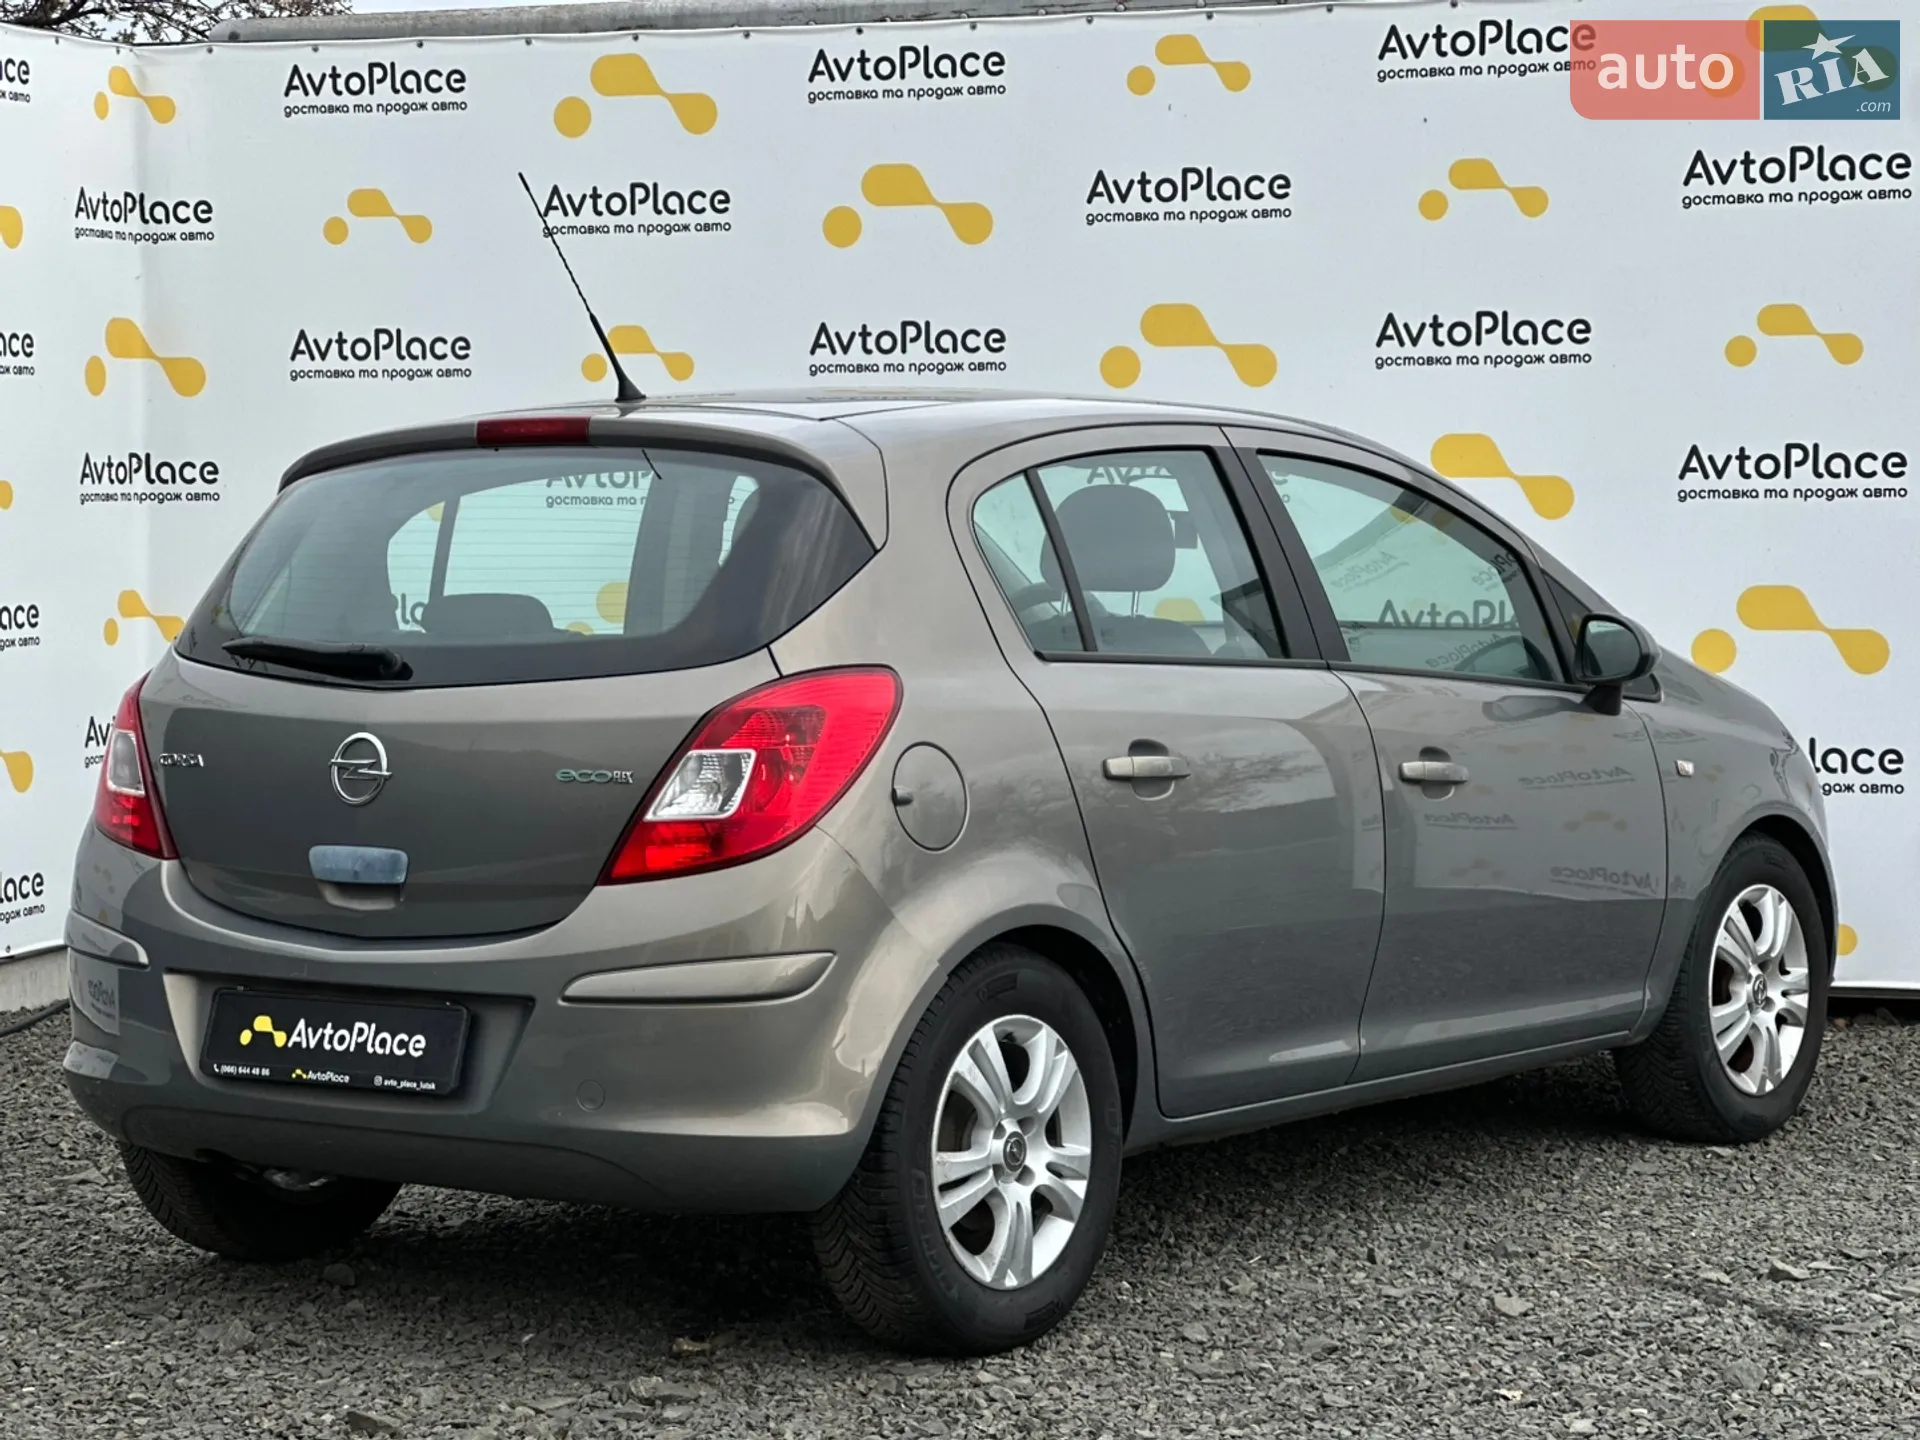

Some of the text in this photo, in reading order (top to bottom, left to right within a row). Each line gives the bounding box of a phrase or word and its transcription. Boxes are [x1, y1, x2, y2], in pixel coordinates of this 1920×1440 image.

[1377, 18, 1597, 61] AvtoPlace
[0, 57, 30, 85] ce
[283, 61, 467, 98] AvtoPlace
[807, 44, 1006, 84] AvtoPlace
[1682, 144, 1912, 187] AvtoPlace
[542, 181, 731, 218] AvtoPlace
[1086, 166, 1292, 205] AvtoPlace
[74, 186, 214, 225] AvtoPlace
[289, 327, 472, 362] AvtoPlace
[809, 319, 1007, 356] AvtoPlace
[1375, 310, 1592, 349] AvtoPlace
[79, 451, 220, 485] AvtoPlace
[1678, 442, 1908, 481] AvtoPlace
[84, 715, 116, 749] Av
[1858, 783, 1905, 795] авто
[287, 1018, 427, 1058] AvtoPlace
[307, 1070, 350, 1084] AvtoPlace
